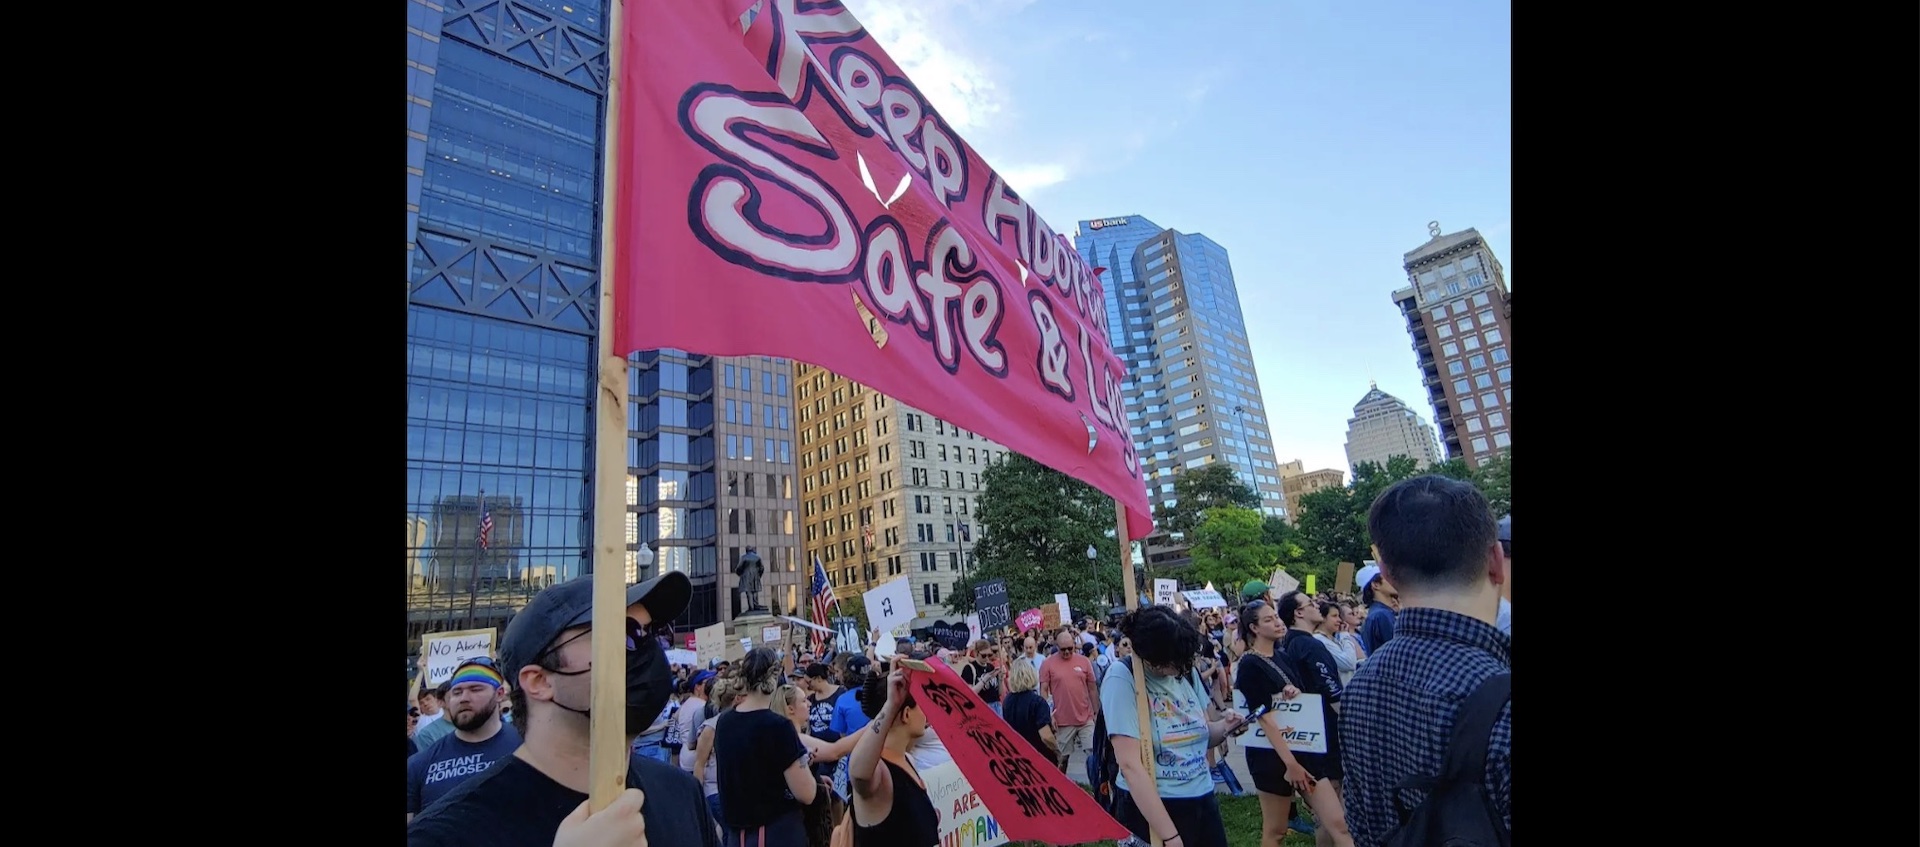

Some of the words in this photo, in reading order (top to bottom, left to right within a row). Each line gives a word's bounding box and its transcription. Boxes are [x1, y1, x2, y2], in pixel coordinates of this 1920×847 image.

[677, 81, 1008, 377] Safe
[1028, 287, 1076, 402] &
[428, 641, 451, 657] No
[455, 640, 492, 653] Abortion
[430, 666, 455, 679] More
[427, 752, 484, 774] DEFIANT
[953, 790, 980, 819] ARE
